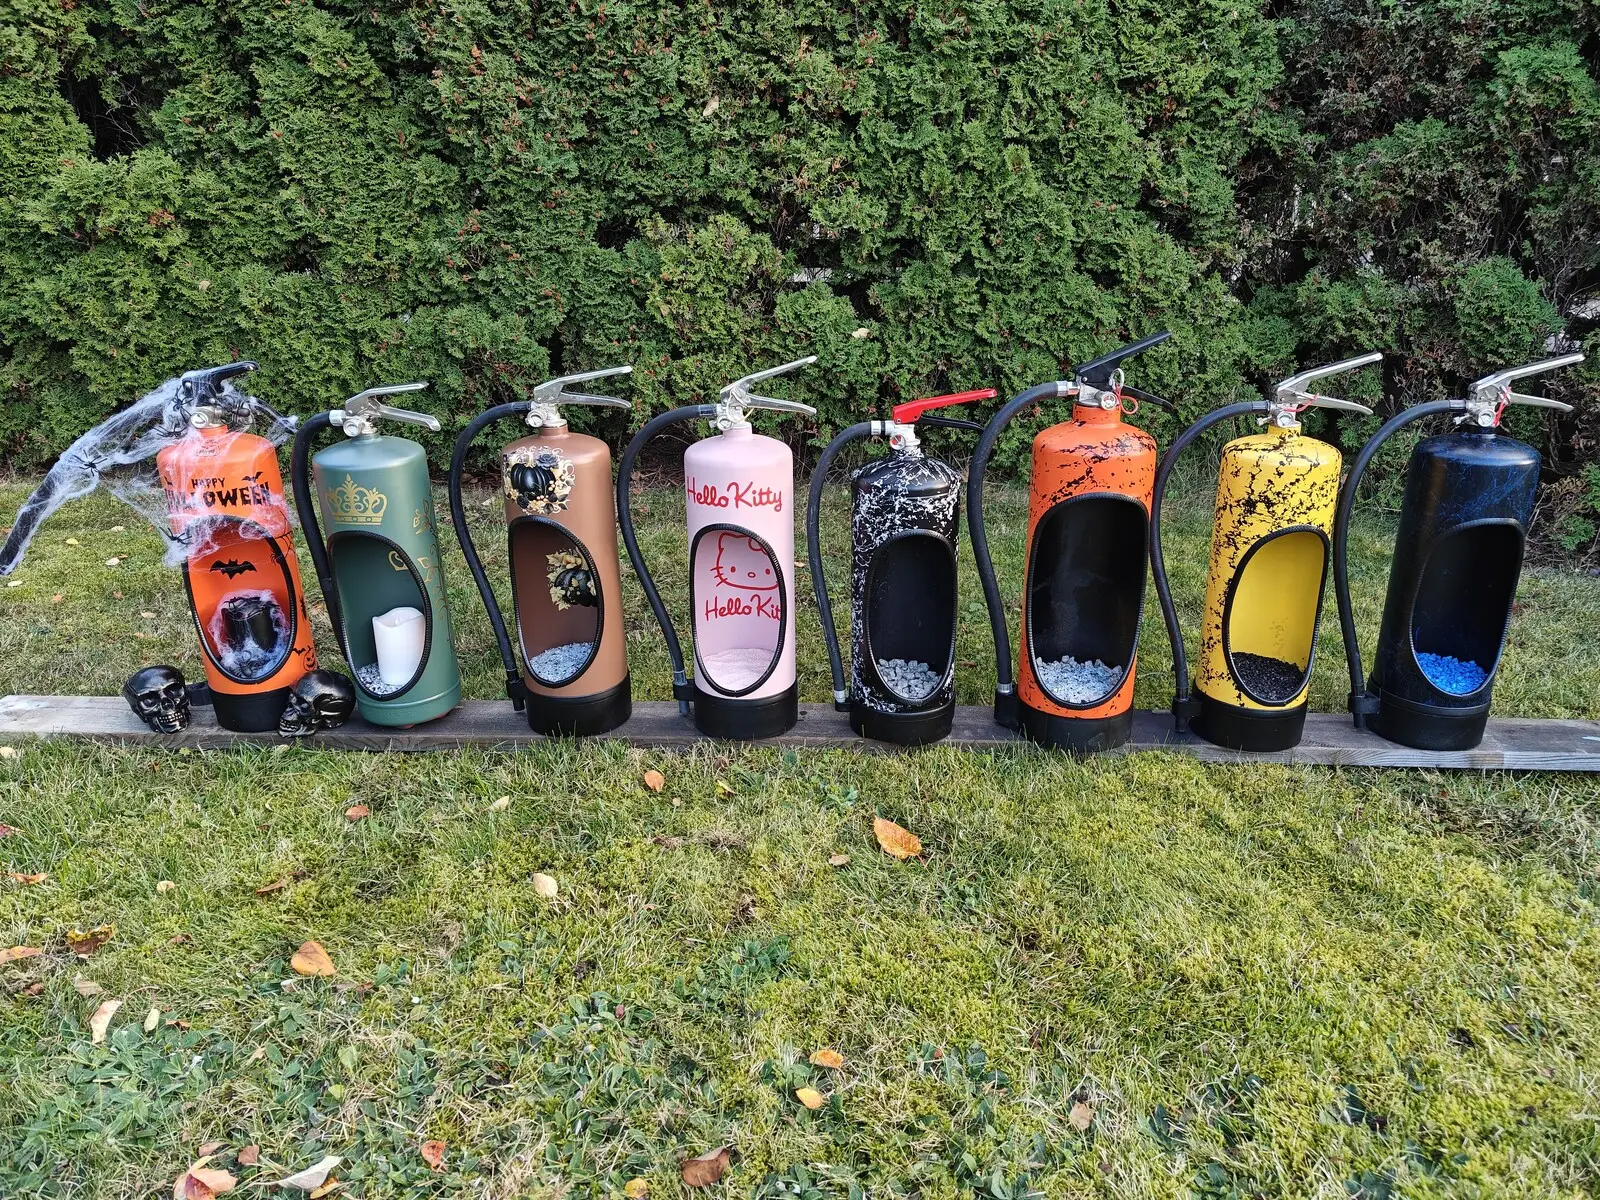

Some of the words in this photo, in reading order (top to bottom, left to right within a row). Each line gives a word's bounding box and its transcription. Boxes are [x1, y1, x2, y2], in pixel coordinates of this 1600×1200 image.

[191, 477, 225, 489] HAPPY
[687, 476, 729, 508] Hello
[727, 481, 782, 512] Kitty
[705, 596, 752, 621] Hello
[750, 594, 781, 621] Kit
